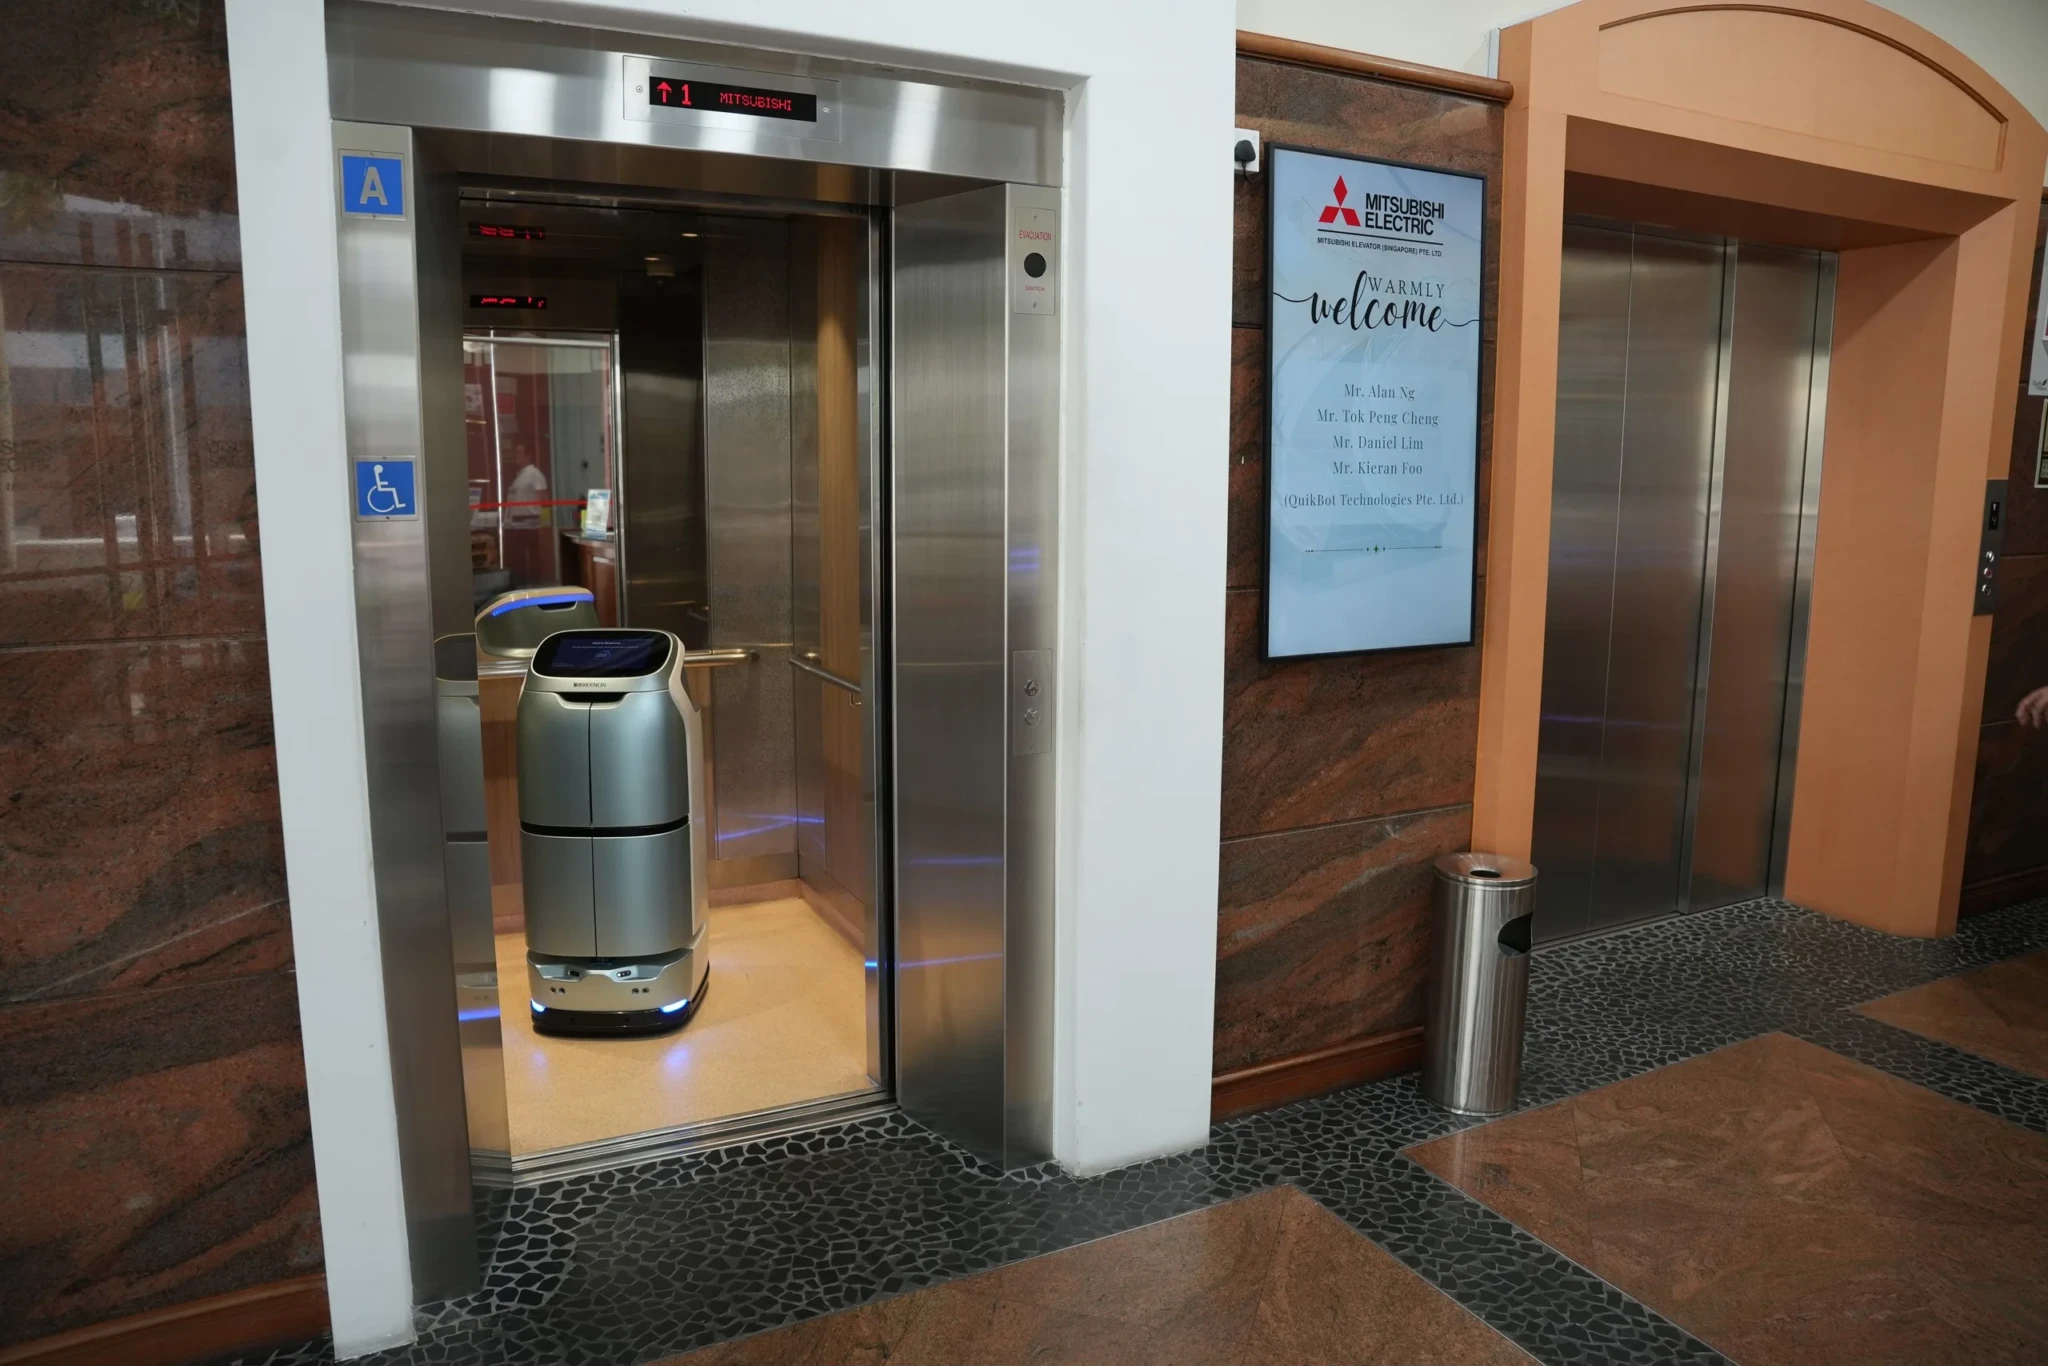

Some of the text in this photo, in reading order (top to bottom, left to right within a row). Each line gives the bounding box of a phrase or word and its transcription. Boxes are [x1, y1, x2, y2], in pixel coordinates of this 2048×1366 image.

[681, 84, 793, 111] 1 MITSUBISHI
[360, 166, 388, 206] A
[1365, 192, 1445, 219] MITSUBISHI
[1365, 211, 1434, 236] ELECTRIC
[1019, 229, 1052, 241] EVACUATION
[1317, 236, 1351, 247] MITSUBISHI
[1351, 242, 1381, 251] ELEVATOR
[1381, 245, 1418, 256] (SINGAPORE)
[1431, 250, 1443, 258] LTD.
[1368, 276, 1445, 299] WARMLY
[1308, 270, 1450, 333] welcome
[1344, 383, 1416, 401] Mr. Alan Ng
[1317, 408, 1439, 427] Mr. Tok Peng Cheng
[1333, 435, 1424, 450] Mr. Daniel Lim
[1332, 461, 1423, 475] Mr. Kieran Foo
[1284, 492, 1464, 509] (QuikBot Technologies Pte. Ltd.)
